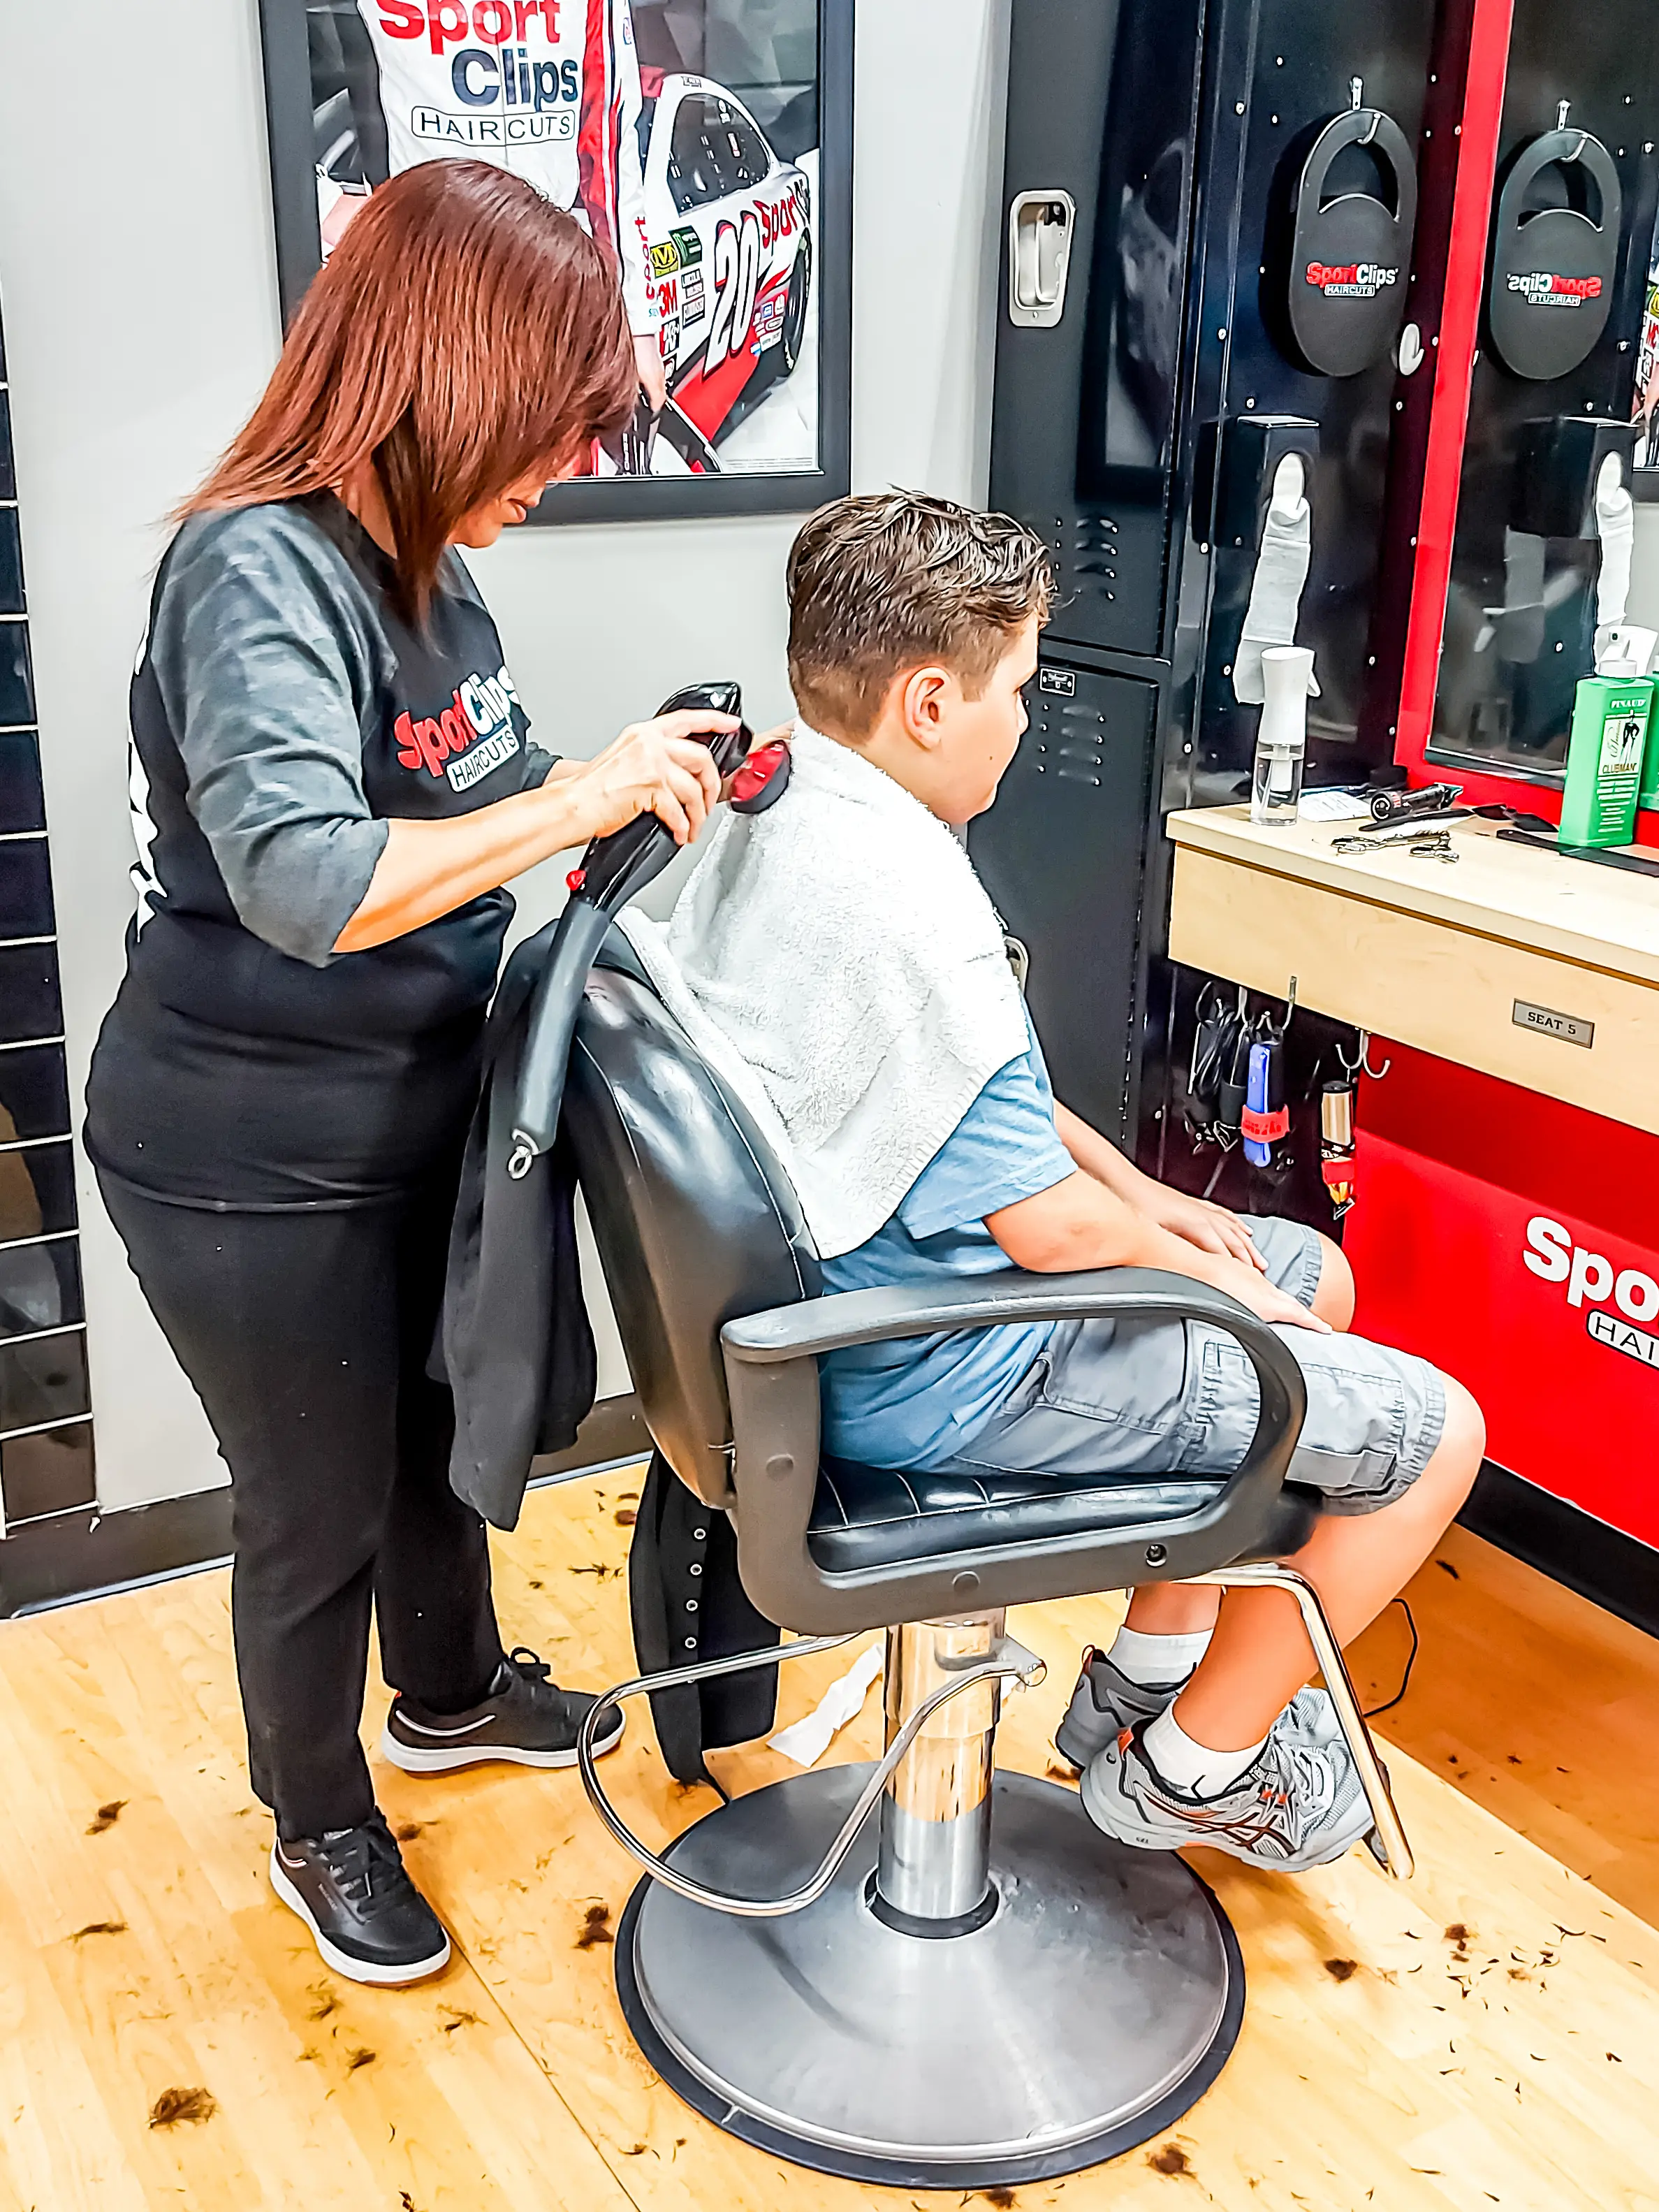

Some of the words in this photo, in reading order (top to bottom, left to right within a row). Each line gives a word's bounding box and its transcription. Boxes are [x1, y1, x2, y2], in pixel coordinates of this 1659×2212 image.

[376, 0, 561, 55] Sport
[452, 48, 578, 112] Clips
[420, 111, 571, 141] HAIRCUTS
[659, 279, 678, 318] 3M
[702, 210, 761, 383] 20
[1326, 285, 1373, 295] HAIRCUTS
[451, 729, 517, 787] HAIRCUTS
[1528, 1011, 1563, 1031] SEAT
[1567, 1024, 1577, 1035] 5
